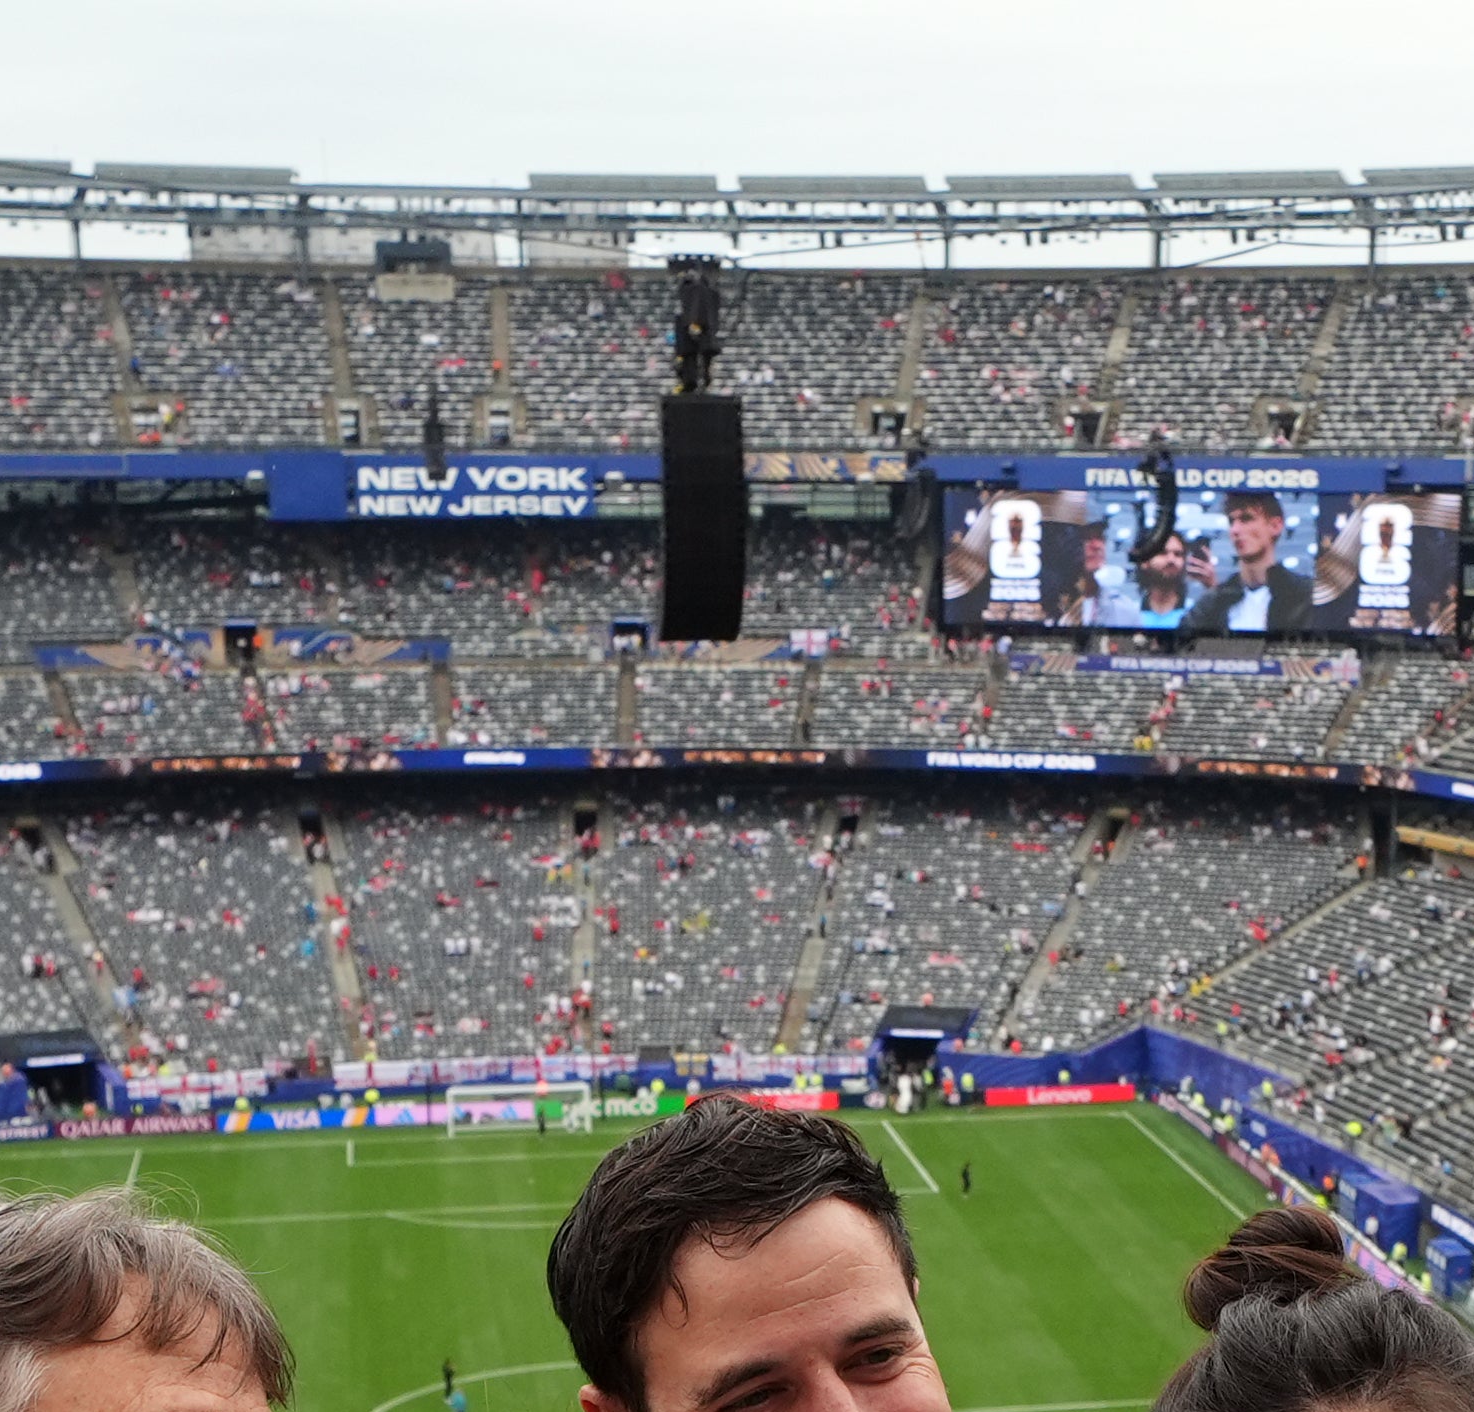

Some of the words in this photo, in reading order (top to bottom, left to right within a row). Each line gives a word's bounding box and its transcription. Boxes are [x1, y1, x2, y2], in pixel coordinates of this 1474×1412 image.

[357, 466, 459, 491] NEW
[466, 466, 588, 491] YORK
[1085, 468, 1128, 487] FIFA
[1203, 469, 1245, 488] CUP
[1246, 469, 1320, 488] 2026
[358, 495, 443, 516] NEW
[447, 495, 588, 517] JERSEY
[1110, 656, 1139, 670] FIFA
[1140, 657, 1187, 672] WORLD
[1187, 658, 1213, 672] CUP
[1213, 659, 1260, 674] 2026
[927, 751, 960, 767] FIFA
[960, 752, 1013, 768] WORLD
[1013, 753, 1043, 769] CUP
[1043, 753, 1097, 771] 2026
[1027, 1085, 1093, 1106] Lenovo
[60, 1118, 126, 1138] QATAR
[130, 1115, 213, 1135] AIRWAYS
[271, 1111, 322, 1129] VISA
